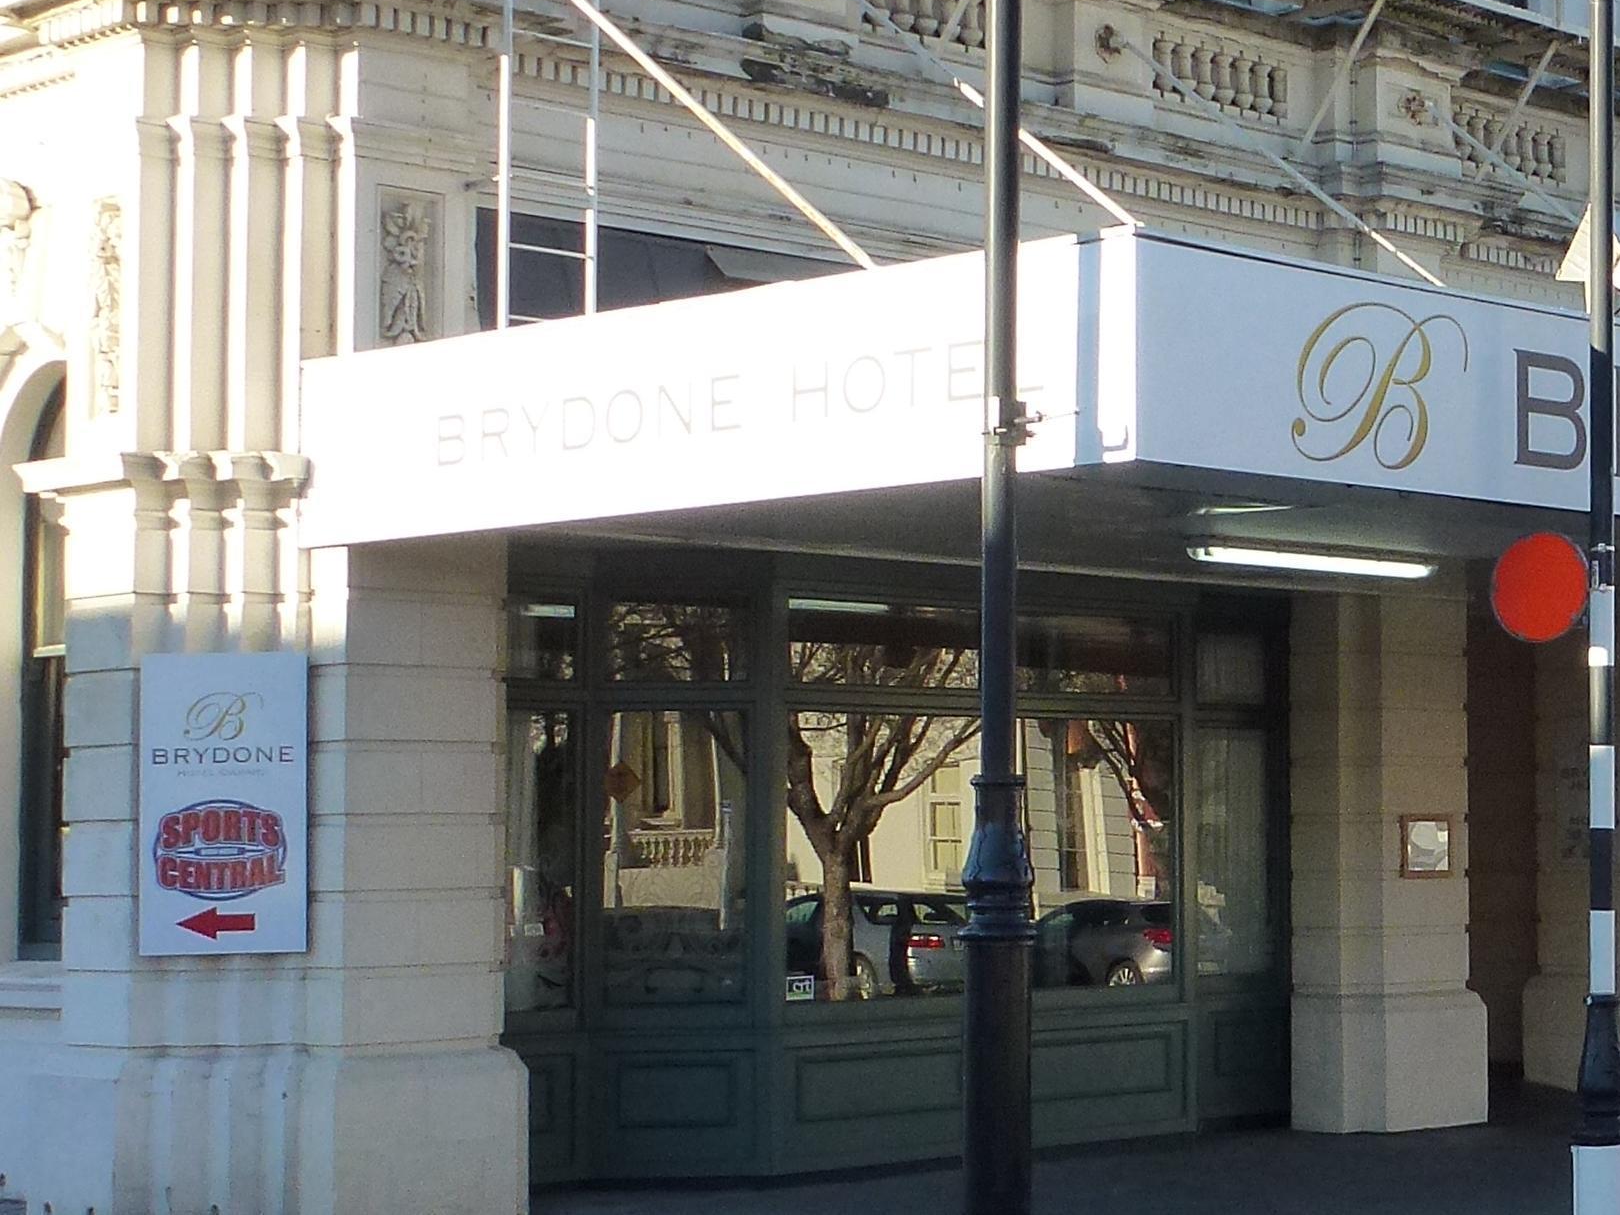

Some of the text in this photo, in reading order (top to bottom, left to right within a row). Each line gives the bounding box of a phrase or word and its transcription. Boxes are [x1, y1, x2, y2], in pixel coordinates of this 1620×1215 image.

[437, 373, 741, 467] BRYDONE
[151, 746, 295, 765] BRYDONE
[160, 806, 283, 851] SPORTS
[157, 851, 286, 890] CENTRAL
